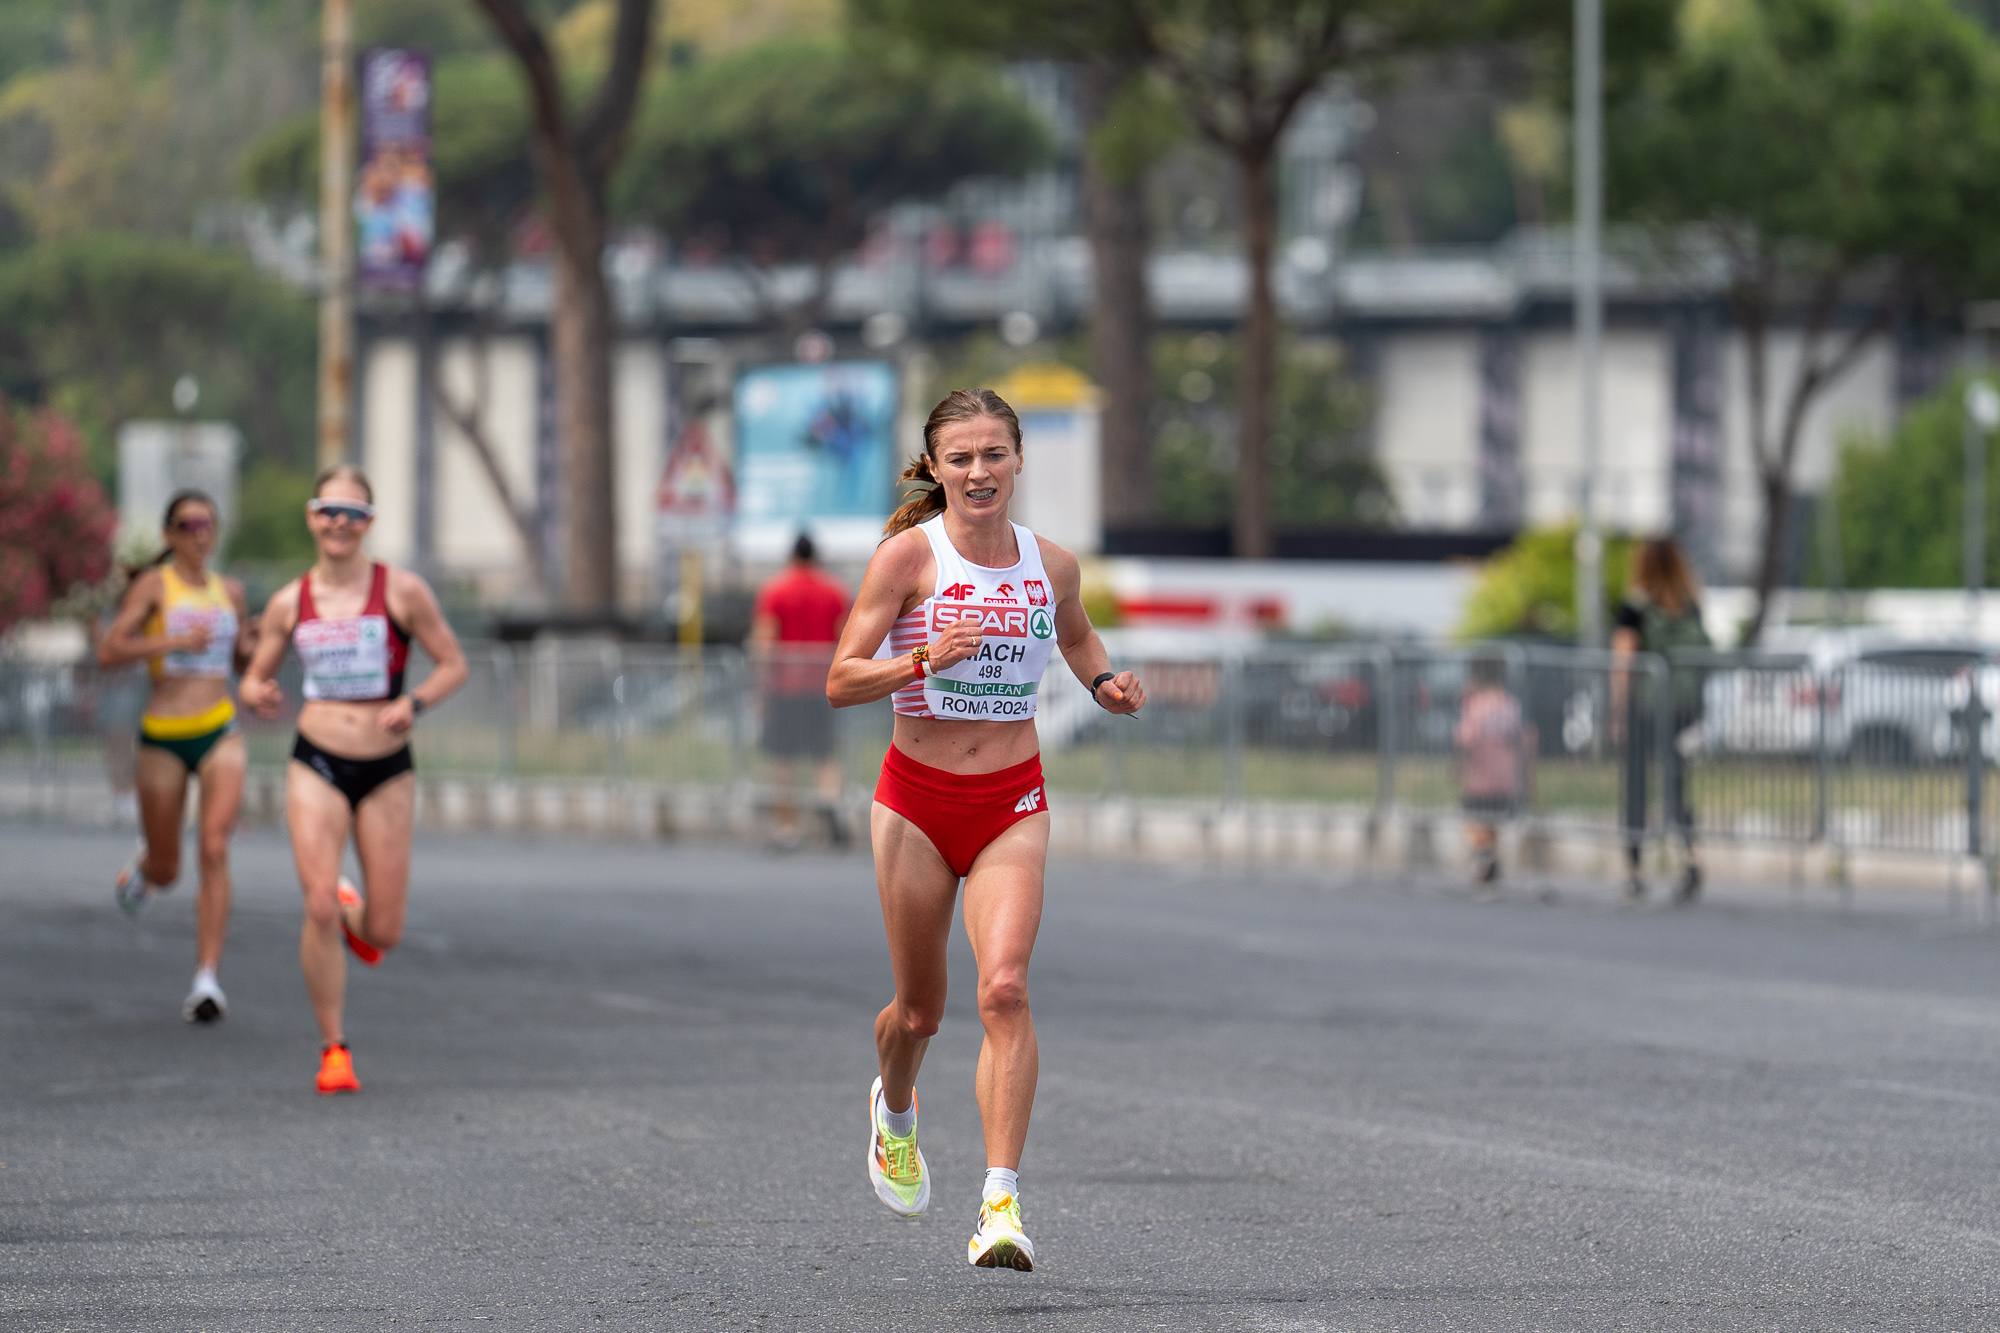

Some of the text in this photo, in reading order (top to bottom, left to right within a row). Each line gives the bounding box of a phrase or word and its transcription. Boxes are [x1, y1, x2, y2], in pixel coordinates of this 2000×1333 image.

[942, 582, 976, 601] 4F
[966, 643, 1026, 663] ACH
[978, 664, 1003, 679] 498
[941, 696, 1028, 715] ROMA 2024
[1014, 785, 1041, 813] 4F
